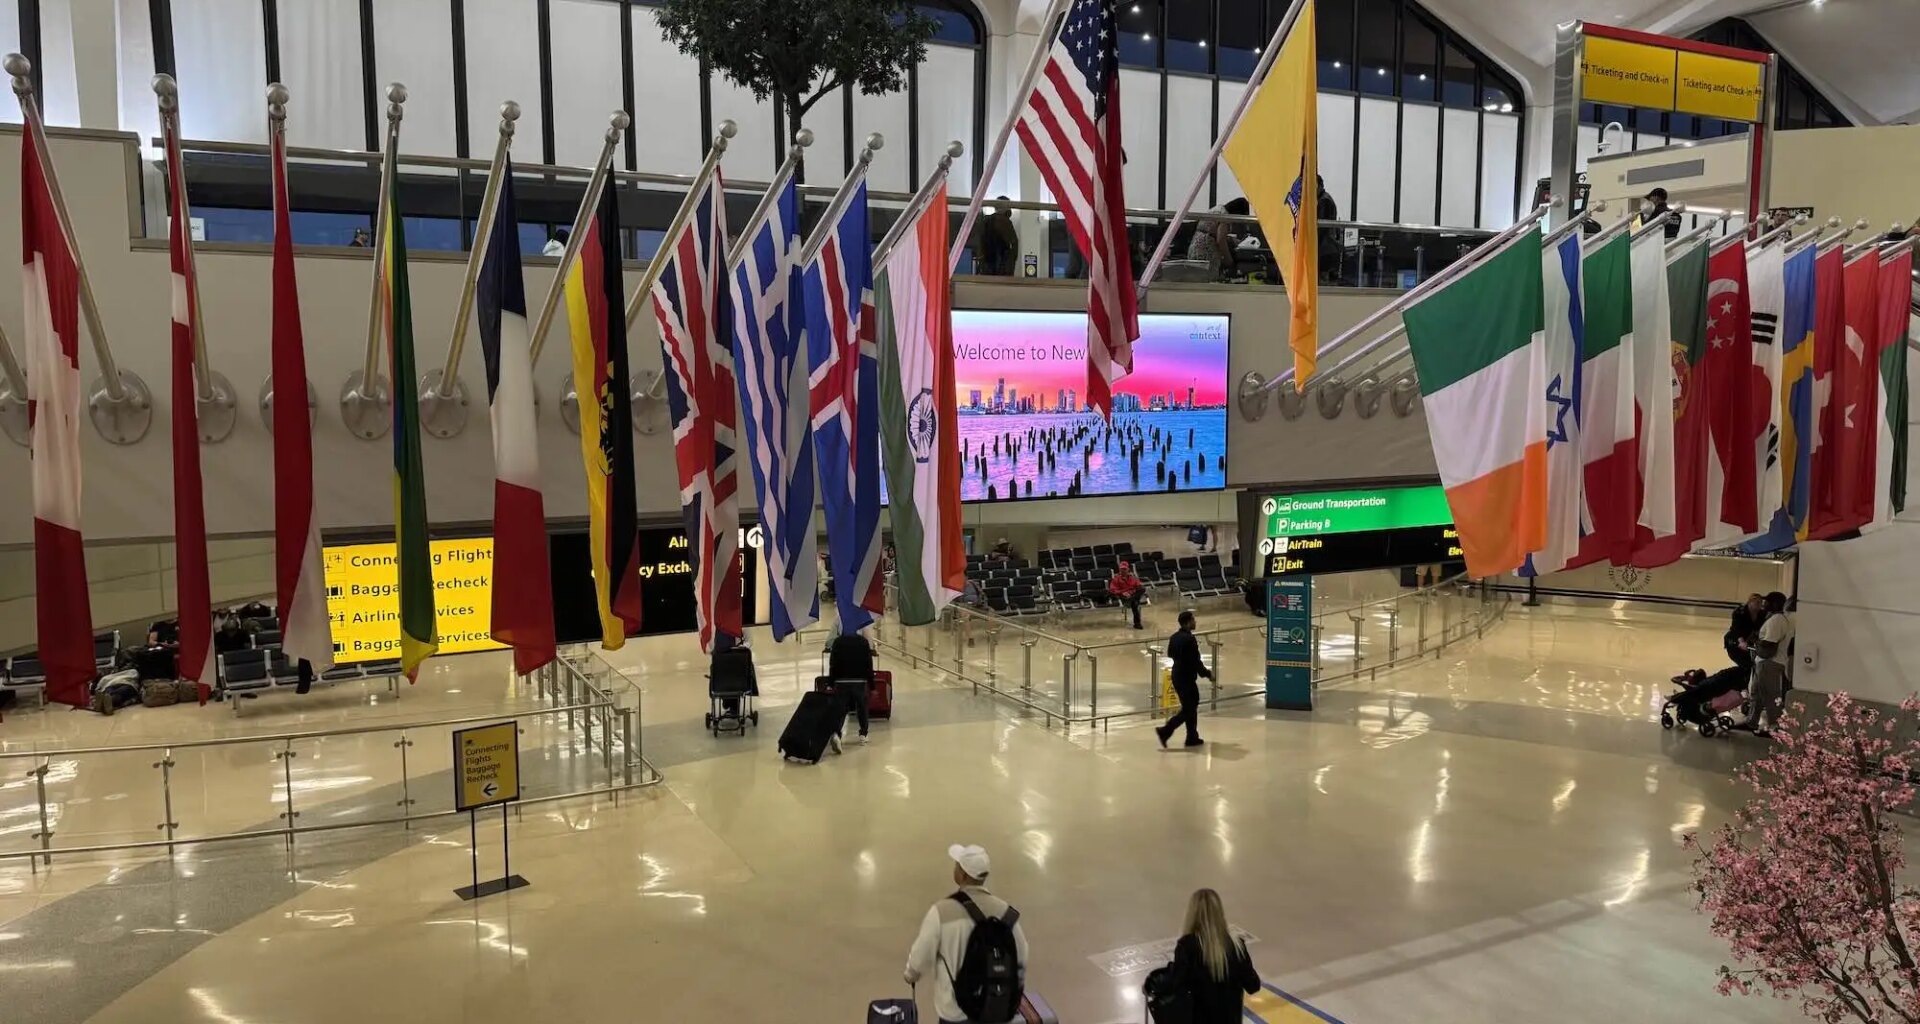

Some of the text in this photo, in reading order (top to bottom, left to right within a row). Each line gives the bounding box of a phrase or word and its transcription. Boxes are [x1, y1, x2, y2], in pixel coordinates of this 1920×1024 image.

[1591, 64, 1669, 86] Ticketing and Check-in
[1683, 78, 1752, 96] Ticketing and Check-in
[954, 343, 1086, 360] Welcome to New
[1292, 497, 1387, 511] Ground Transportation
[1290, 519, 1323, 531] Parking
[1288, 539, 1322, 550] AirTrain
[448, 549, 492, 563] Flight
[658, 561, 692, 575] Exch
[1286, 560, 1304, 570] Exit
[352, 576, 488, 597] Bagga echeck
[352, 605, 475, 624] Airlin vices
[354, 630, 490, 652] Bagga ervices
[465, 744, 508, 755] Connecting
[465, 756, 491, 765] Flights
[466, 763, 500, 774] Baggage
[466, 773, 498, 783] Recheck
